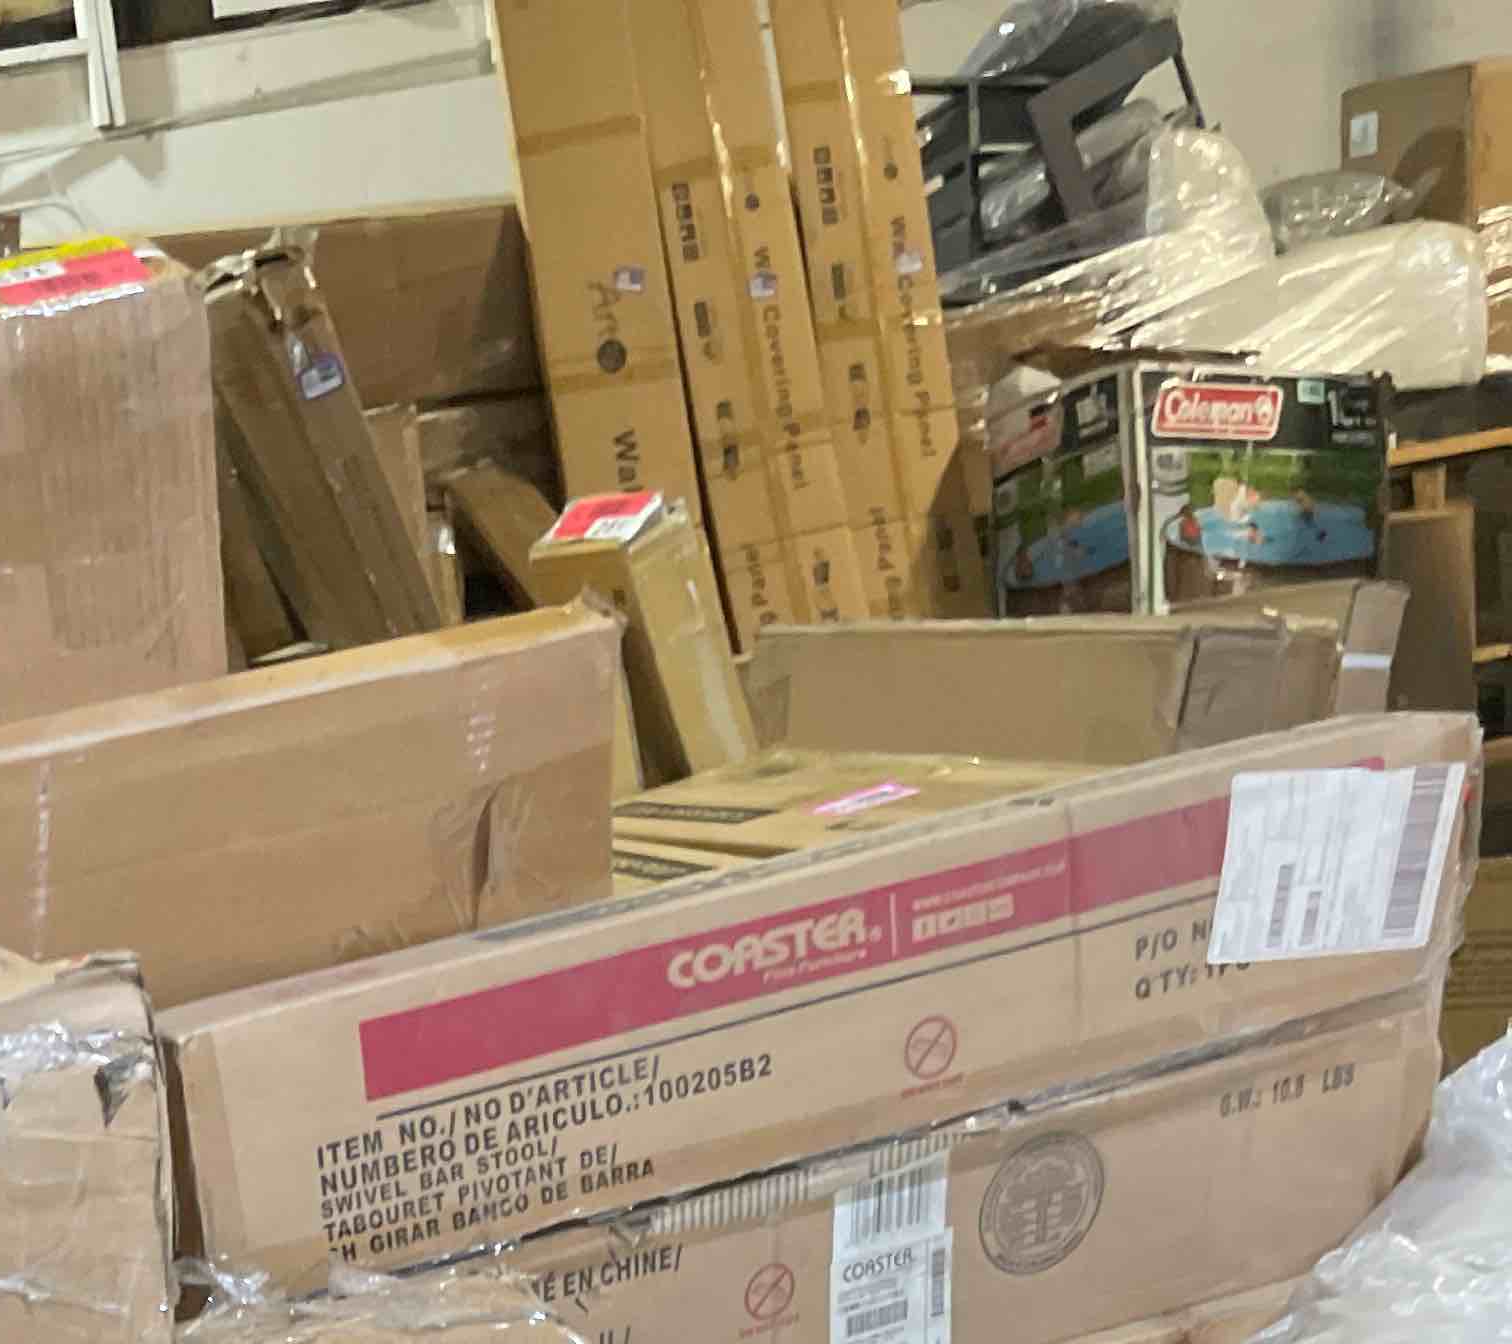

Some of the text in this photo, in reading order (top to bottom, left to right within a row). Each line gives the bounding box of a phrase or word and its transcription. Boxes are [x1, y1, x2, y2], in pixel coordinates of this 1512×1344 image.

[1164, 388, 1253, 425] Coleman
[668, 908, 866, 988] COASTER
[1136, 928, 1178, 962] P/O
[317, 1055, 659, 1169] ITEM NO./ NO D'ARTICLE/
[320, 1139, 456, 1197] NUMBERO
[464, 1128, 498, 1155] DE
[321, 1136, 558, 1220] SWIVEL BAR STOOL/
[322, 1143, 617, 1243] TABOURET PIVOTANT DE/
[370, 1219, 441, 1254] GIRAR
[541, 1182, 568, 1205] DE
[581, 1159, 654, 1194] BARRA
[563, 1266, 593, 1297] EN
[600, 1243, 683, 1286] CHINE/
[842, 1248, 914, 1283] COASTER
